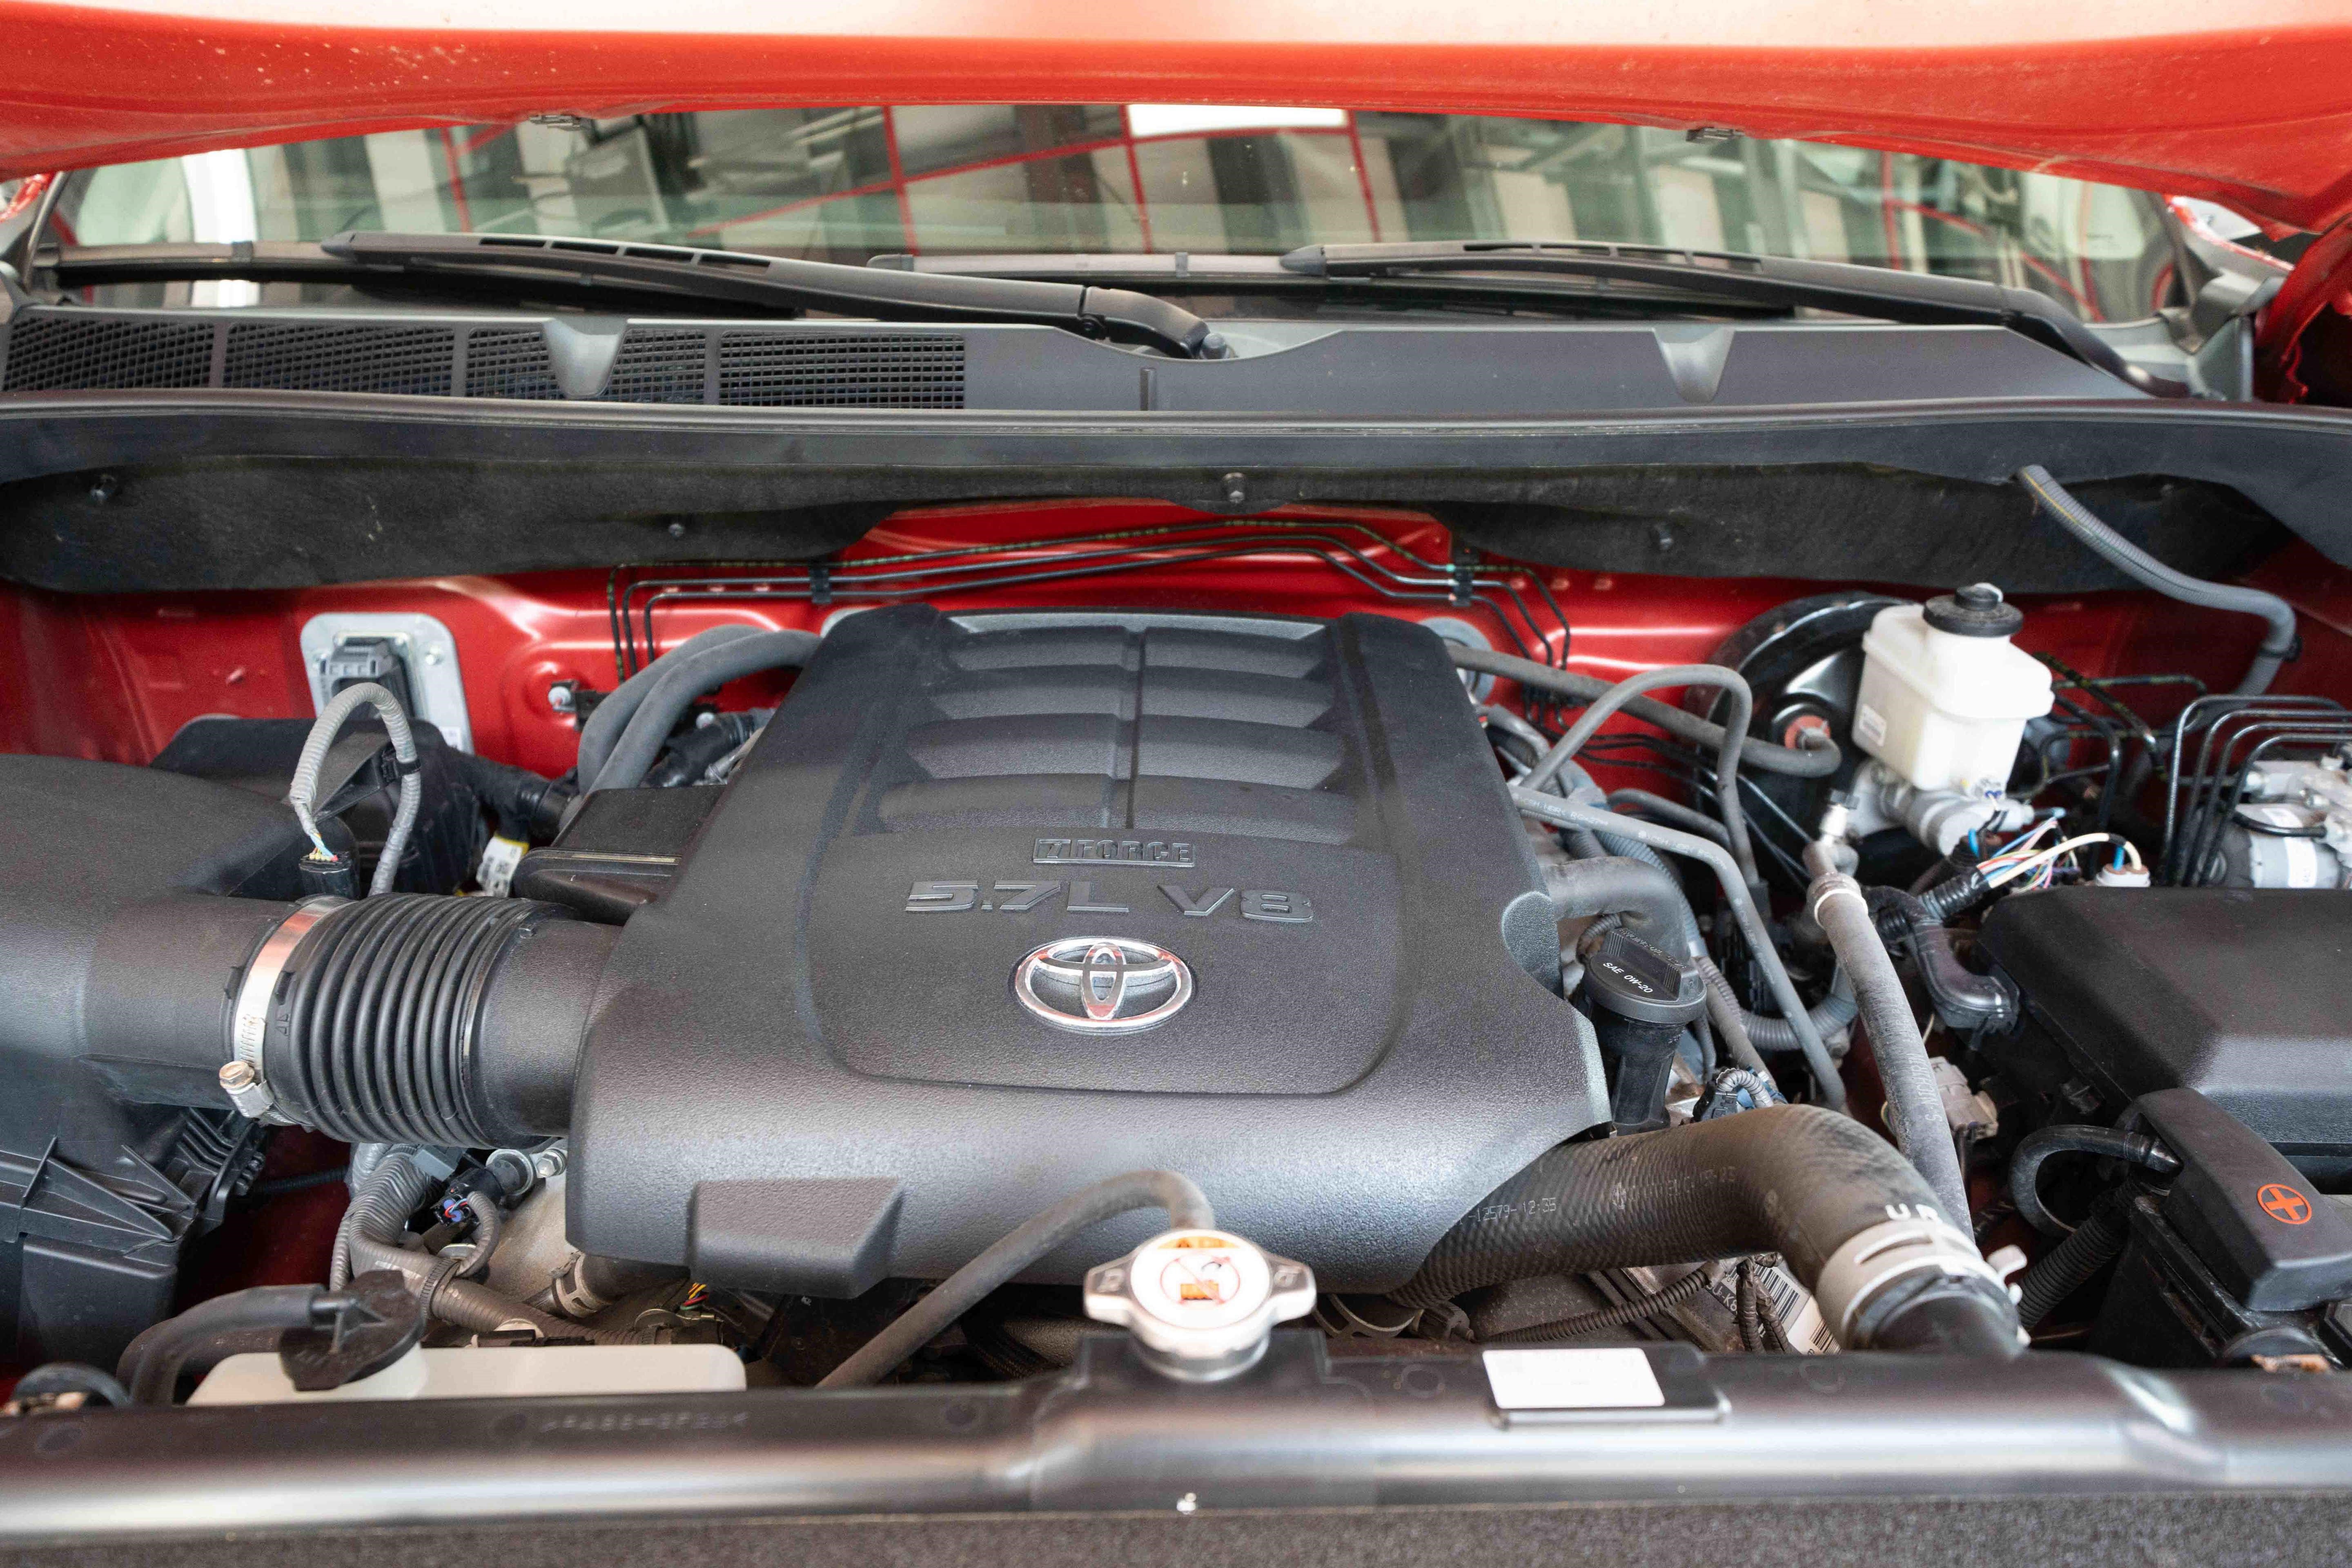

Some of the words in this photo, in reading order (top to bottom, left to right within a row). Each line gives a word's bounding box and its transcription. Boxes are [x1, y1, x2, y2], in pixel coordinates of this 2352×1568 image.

[1076, 839, 1190, 863] FORCE
[905, 880, 1130, 914] 5.7L
[1157, 884, 1314, 923] V8
[1603, 962, 1625, 974] SAE
[1623, 974, 1654, 994] 0W-20
